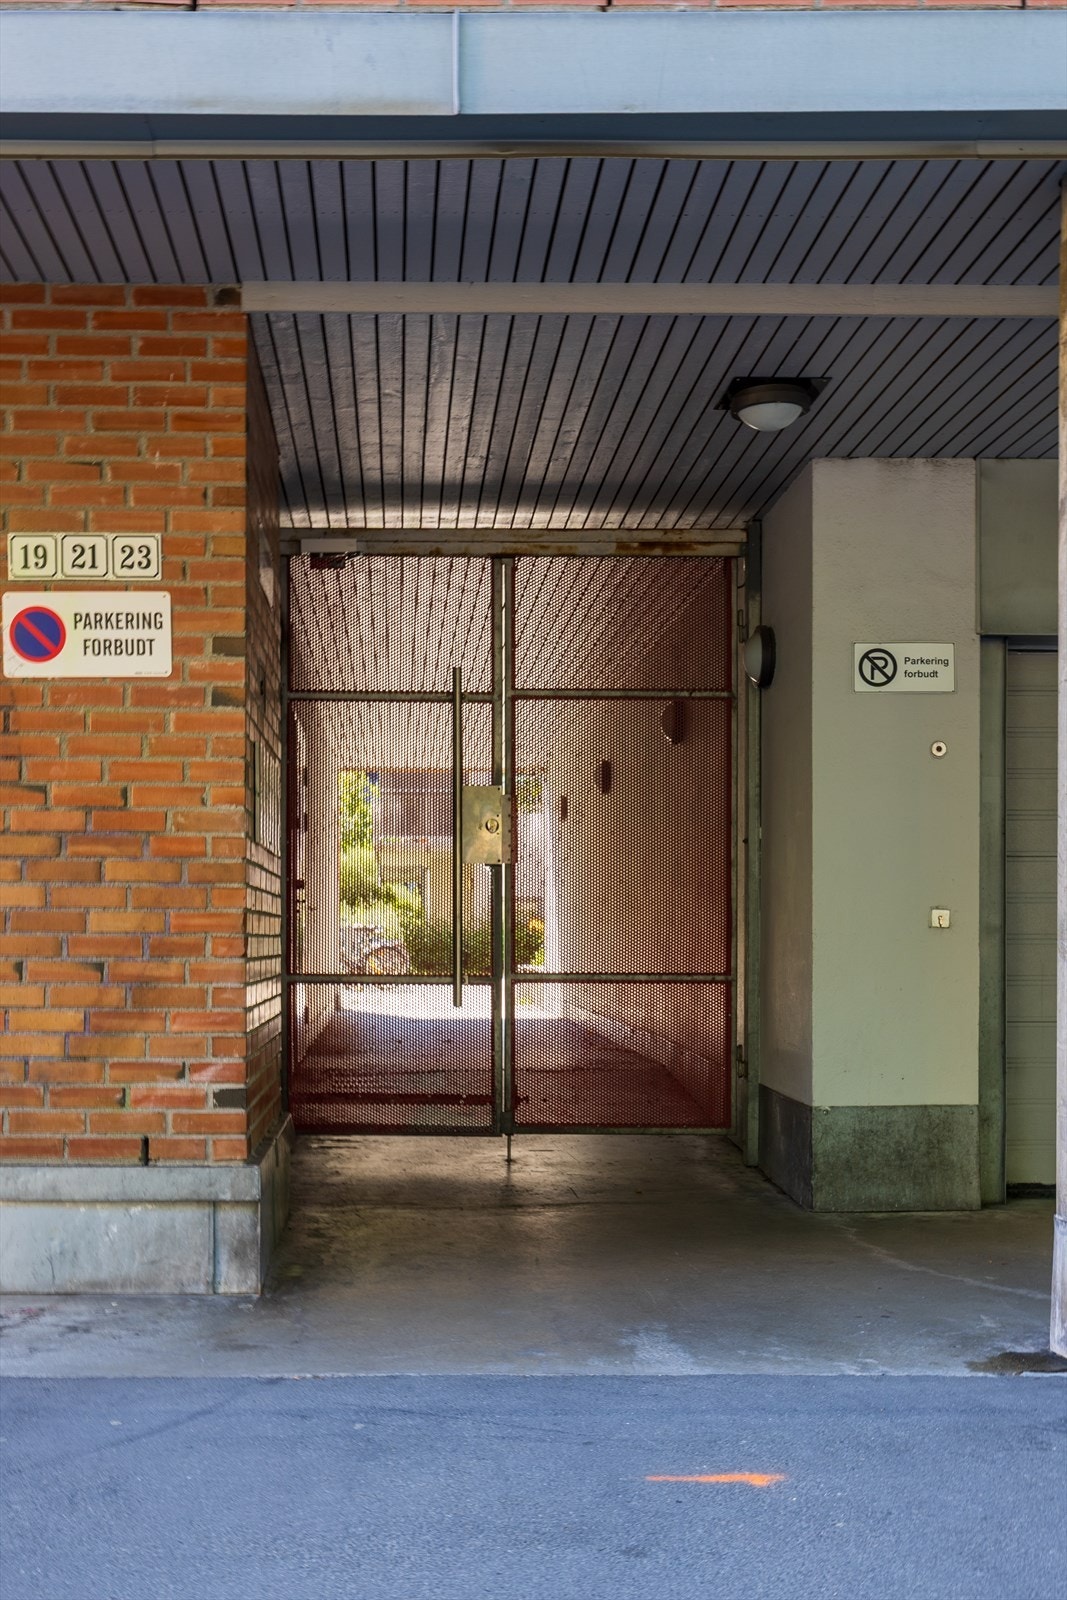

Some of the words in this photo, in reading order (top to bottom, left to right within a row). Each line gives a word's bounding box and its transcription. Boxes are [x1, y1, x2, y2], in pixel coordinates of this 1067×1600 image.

[20, 544, 48, 570] 19
[71, 544, 99, 570] 21
[120, 544, 152, 570] 23
[73, 612, 163, 630] PARKERING
[83, 638, 156, 656] FORBUDT
[904, 656, 949, 667] Parkering
[904, 669, 939, 678] forbudt
